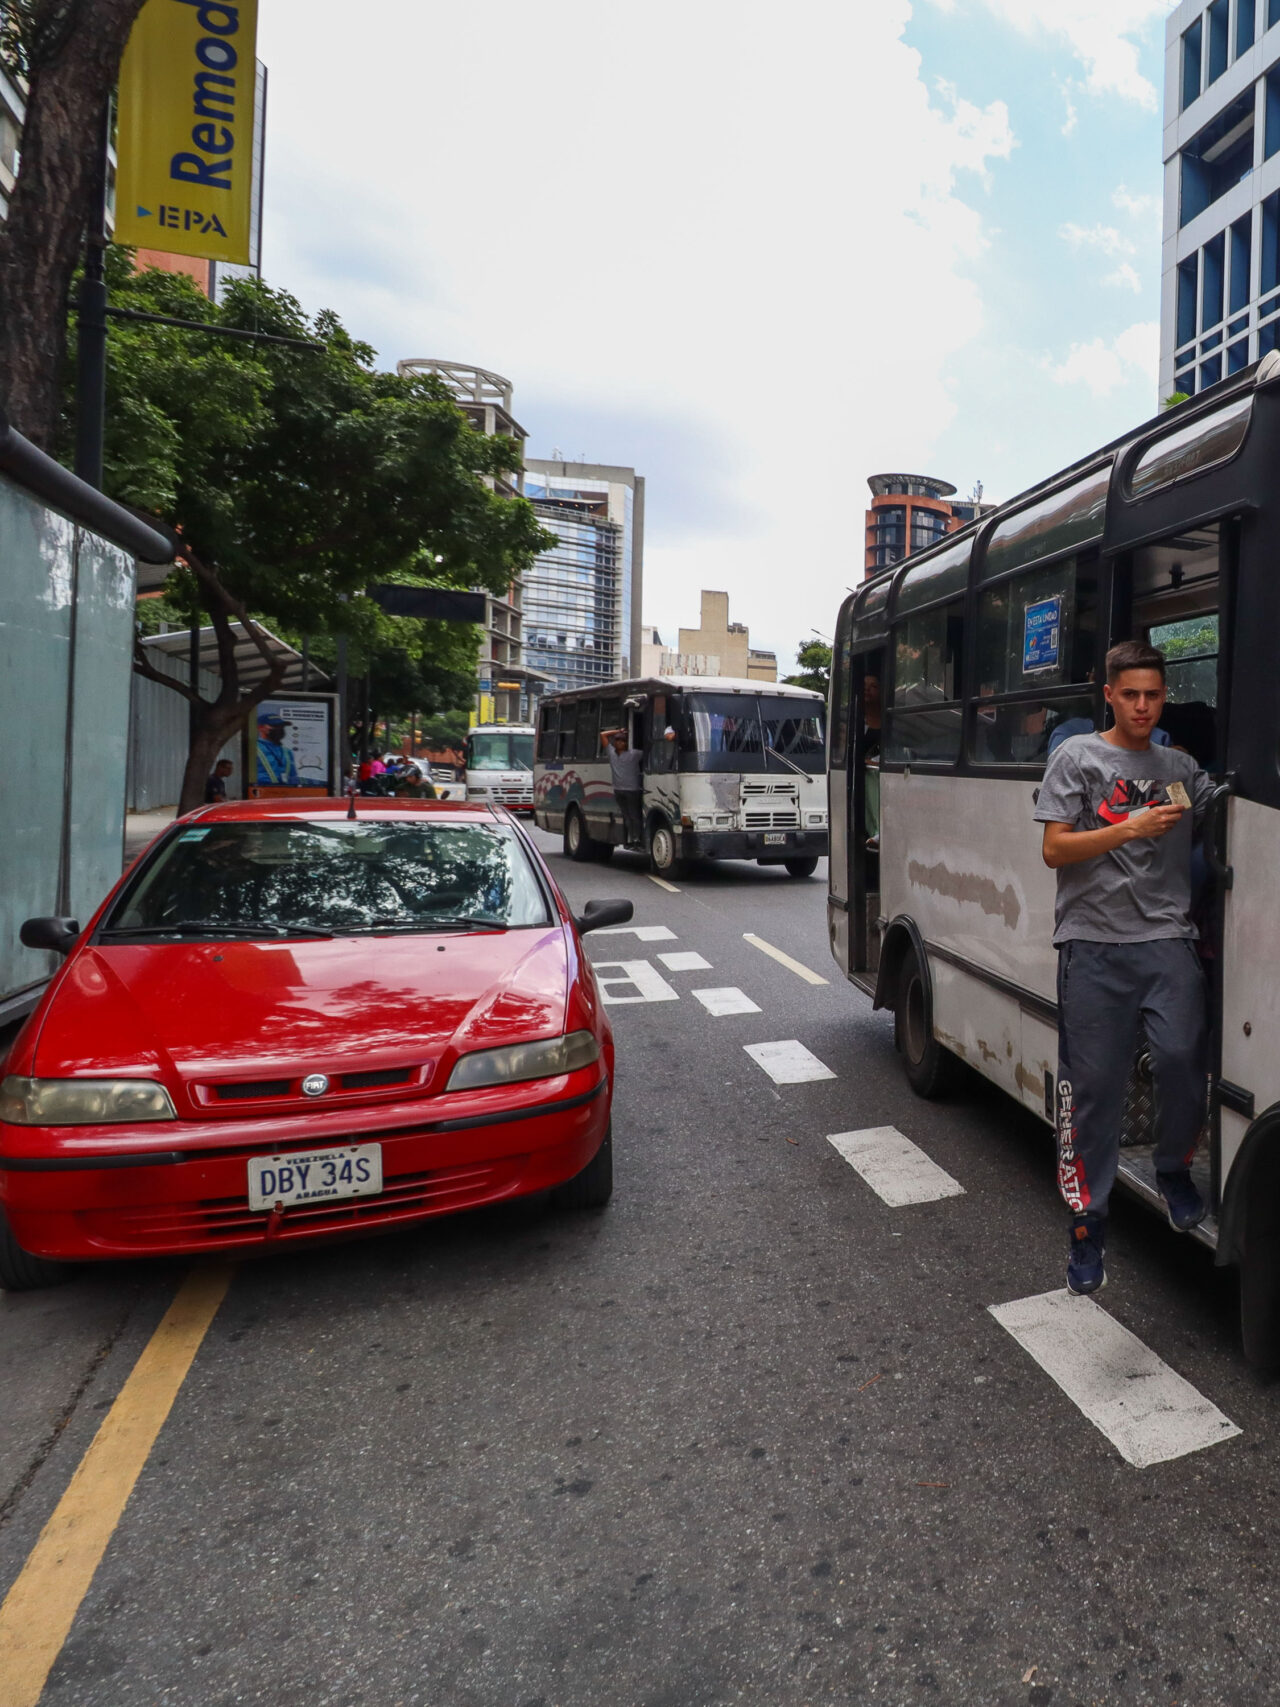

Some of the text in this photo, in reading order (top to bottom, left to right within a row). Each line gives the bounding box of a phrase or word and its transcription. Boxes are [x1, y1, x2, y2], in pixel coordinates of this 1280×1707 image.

[169, 0, 239, 190] Remod
[159, 205, 228, 238] EPA
[306, 1080, 325, 1090] FIAT
[286, 1153, 345, 1165] VENEZUELA
[1058, 1080, 1088, 1216] GENERATIO
[260, 1157, 371, 1196] DBY 34S
[295, 1188, 338, 1200] ARAGUA
